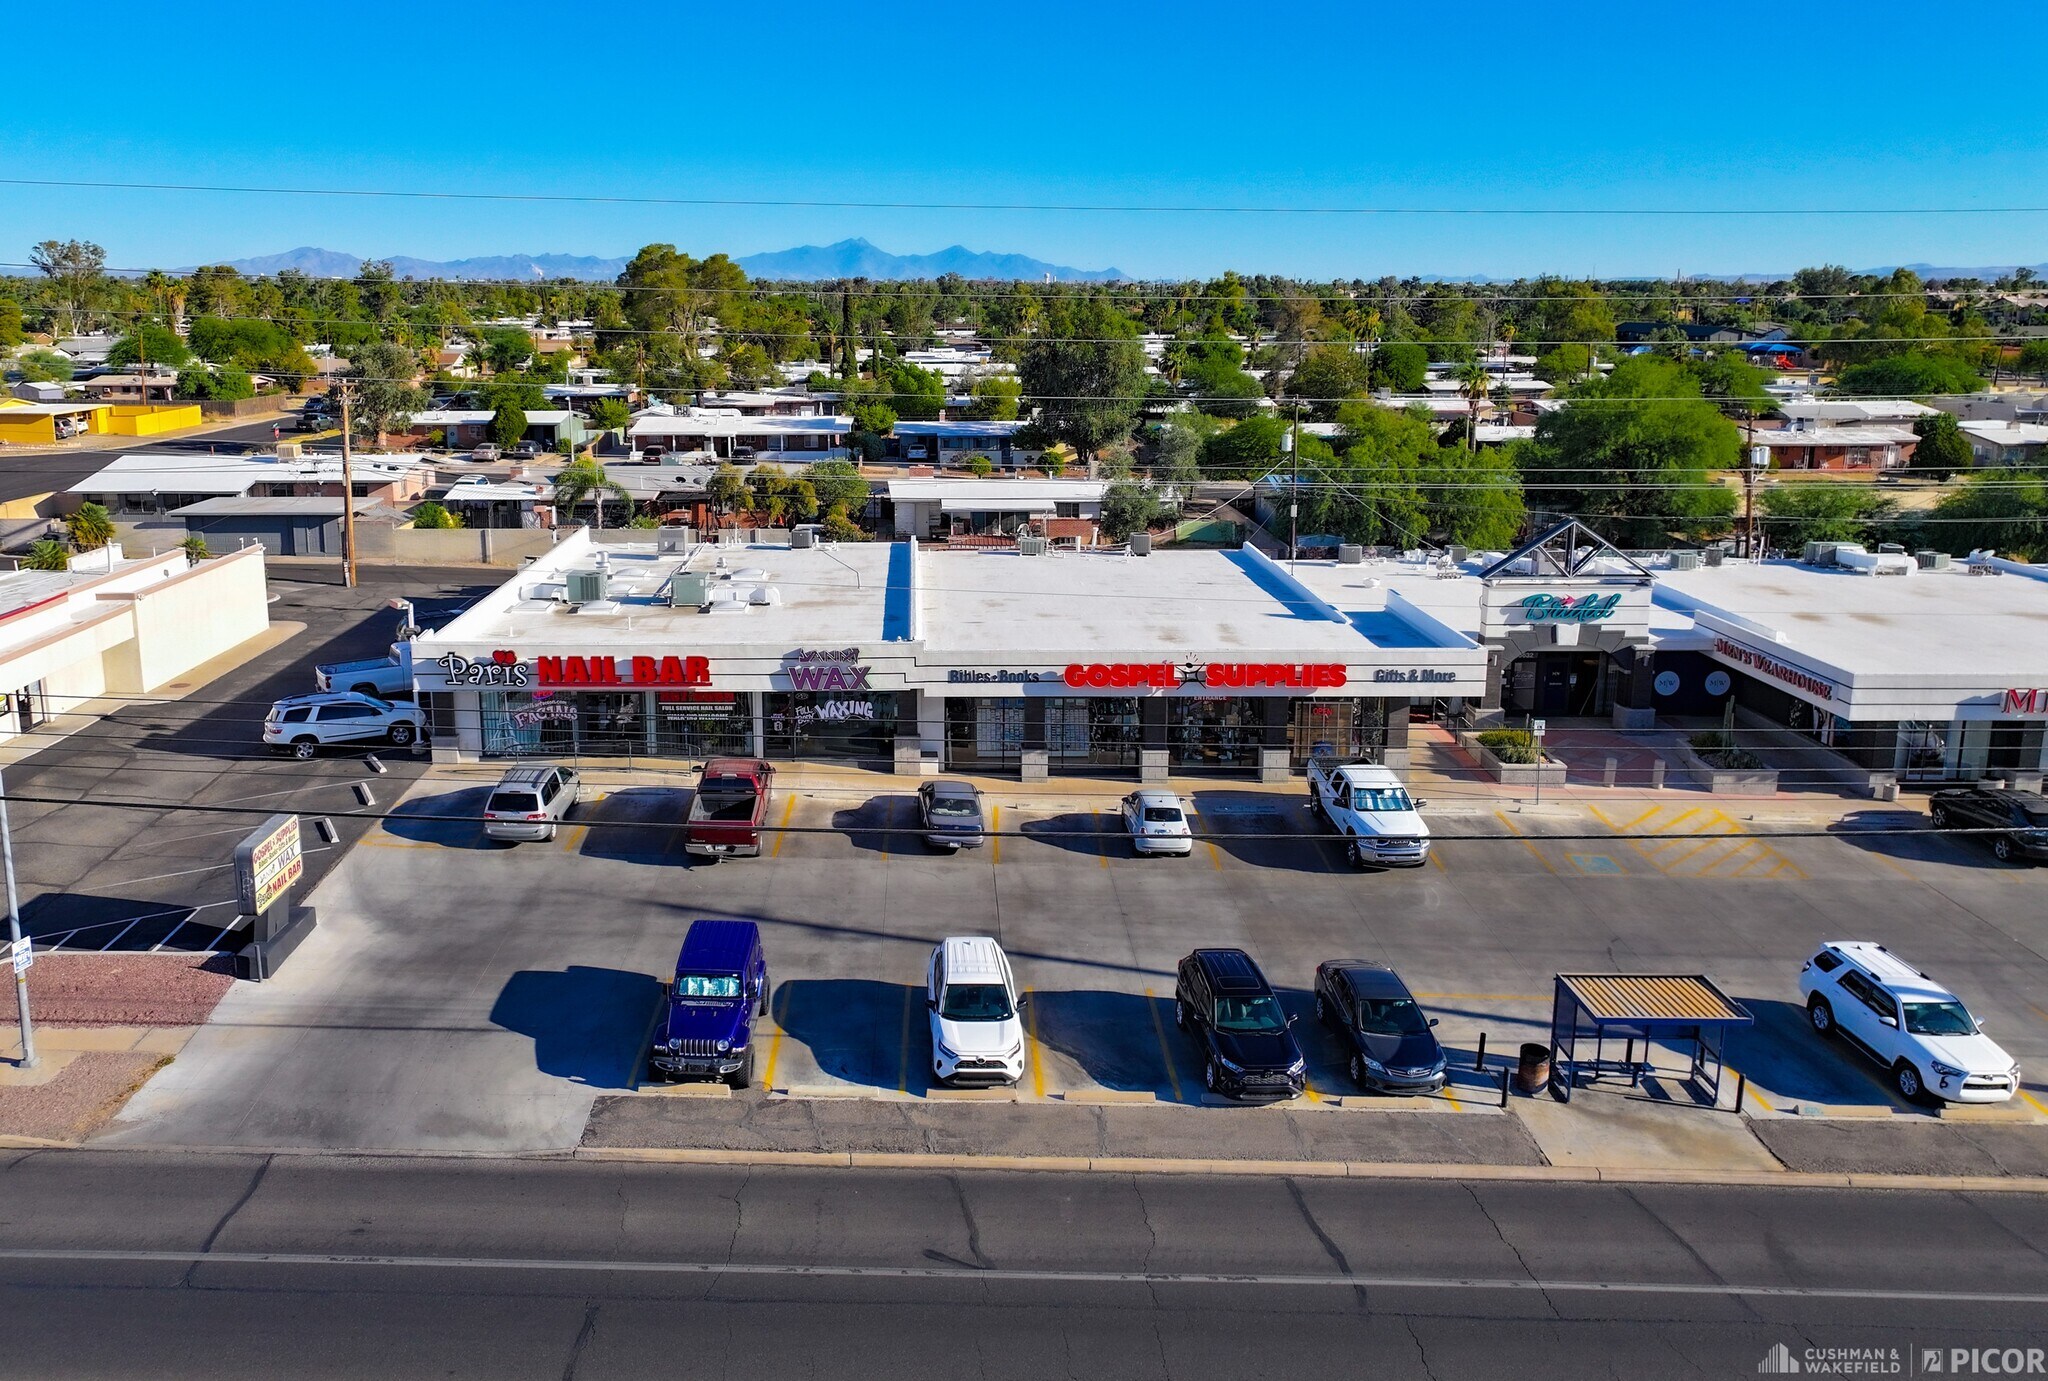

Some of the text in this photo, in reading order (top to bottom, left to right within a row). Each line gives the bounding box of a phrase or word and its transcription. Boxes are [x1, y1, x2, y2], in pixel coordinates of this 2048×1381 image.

[1522, 593, 1621, 621] Bridal
[1714, 638, 1752, 665] MEN'S
[438, 651, 710, 687] Paris NAIL BAR
[788, 666, 872, 691] WAX
[948, 669, 1040, 683] Bibles Books
[1064, 663, 1347, 688] GOSPEL SUPPLIES
[1373, 669, 1456, 683] Gifts & More
[514, 704, 578, 729] FACIALS
[815, 700, 873, 720] WAXING
[1313, 707, 1333, 715] OPEN
[254, 818, 298, 864] GOSPEL SUPPLIES
[277, 845, 296, 869] WAX
[272, 876, 287, 894] NAIL
[288, 860, 302, 878] BAR
